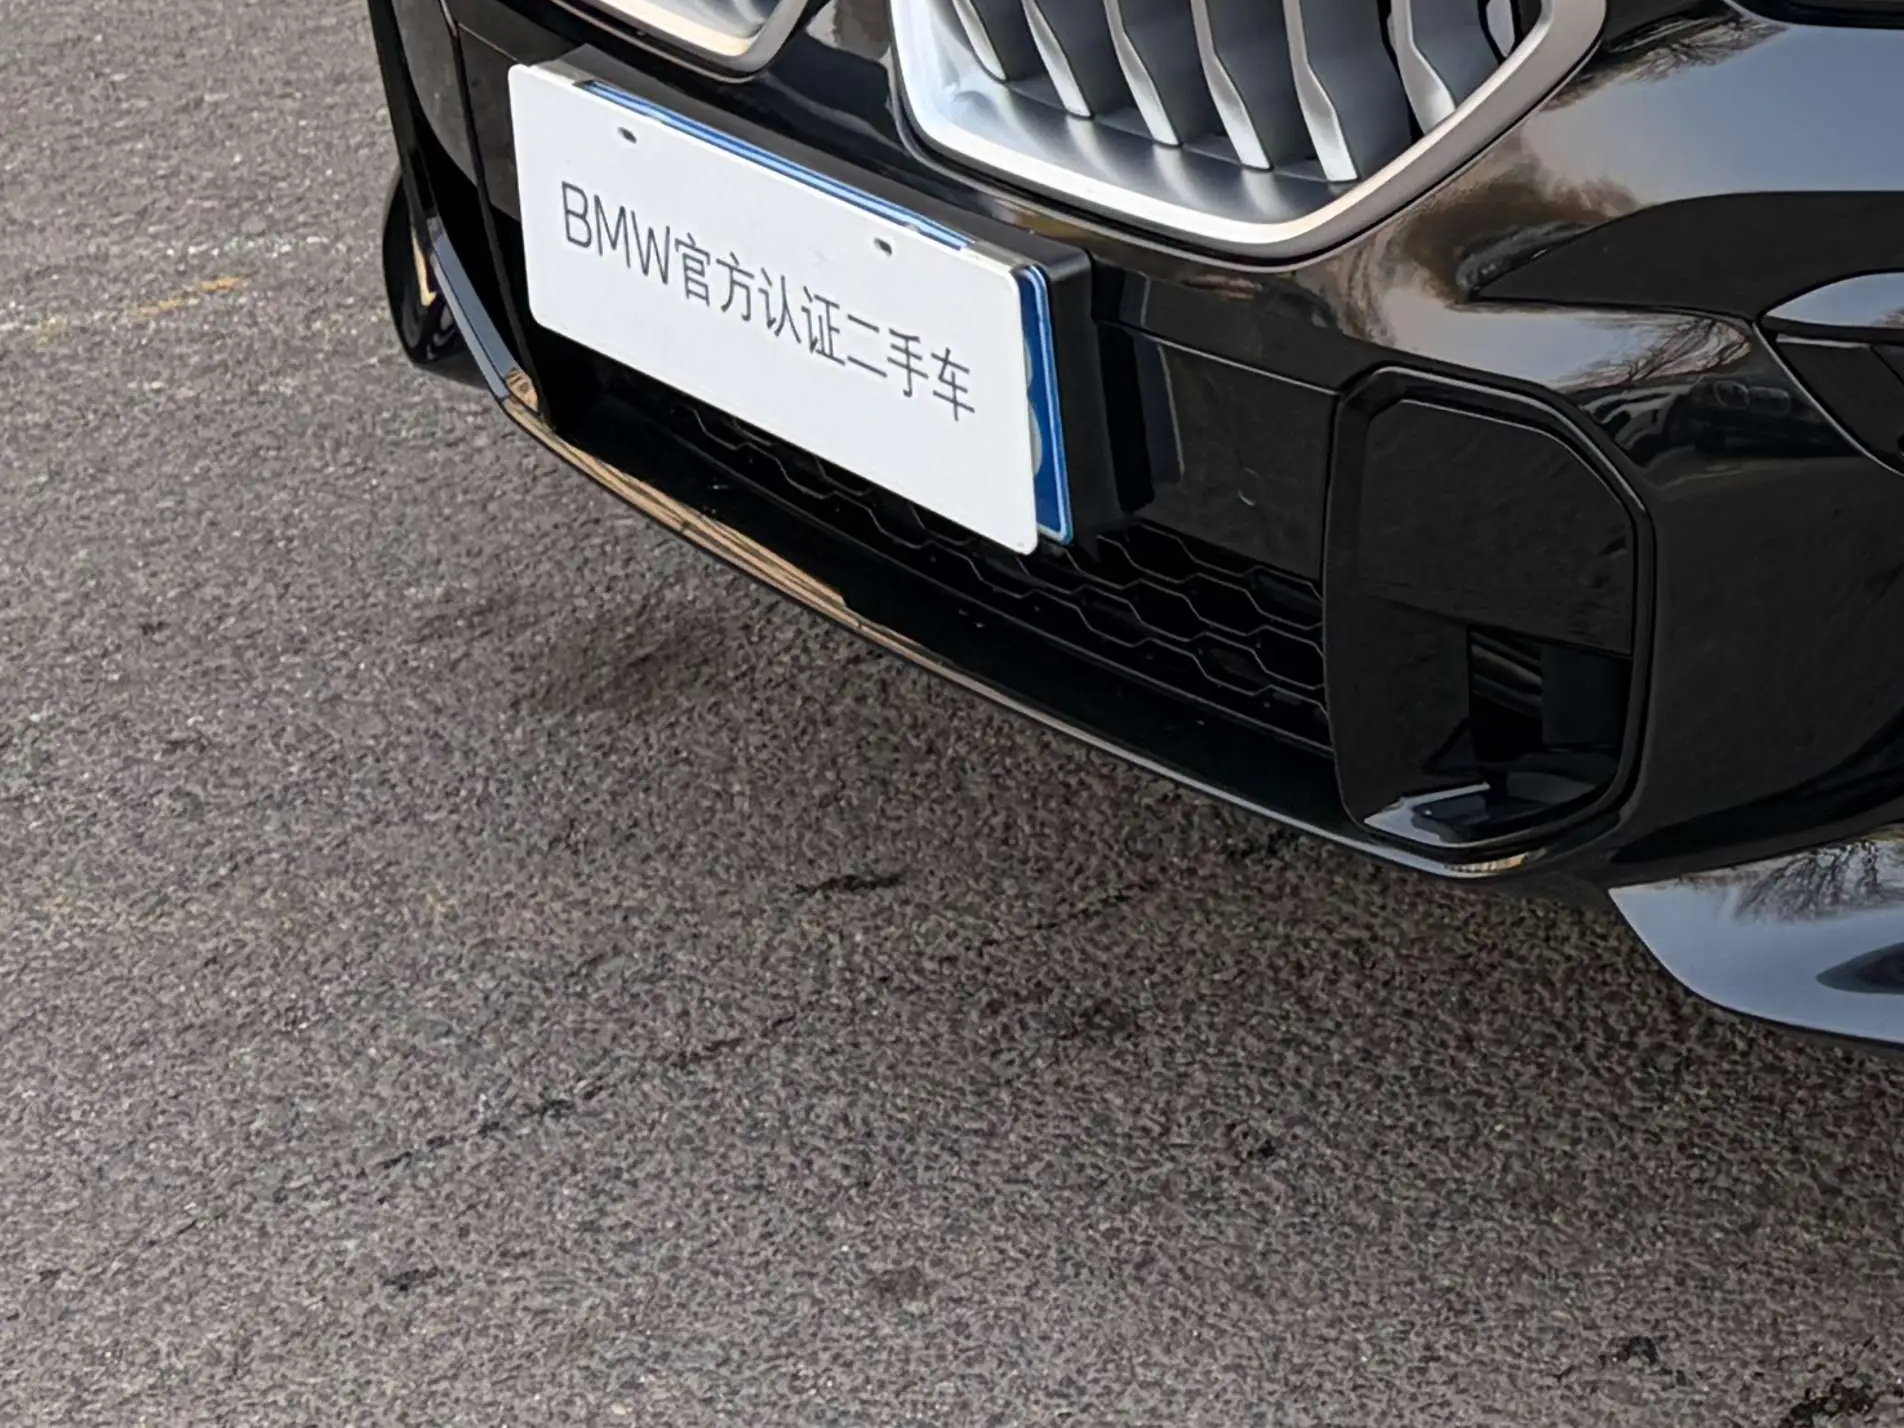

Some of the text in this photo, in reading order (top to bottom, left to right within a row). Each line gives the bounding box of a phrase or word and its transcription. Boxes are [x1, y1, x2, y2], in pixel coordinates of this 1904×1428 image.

[561, 180, 976, 423] BMW官方认证二手车
